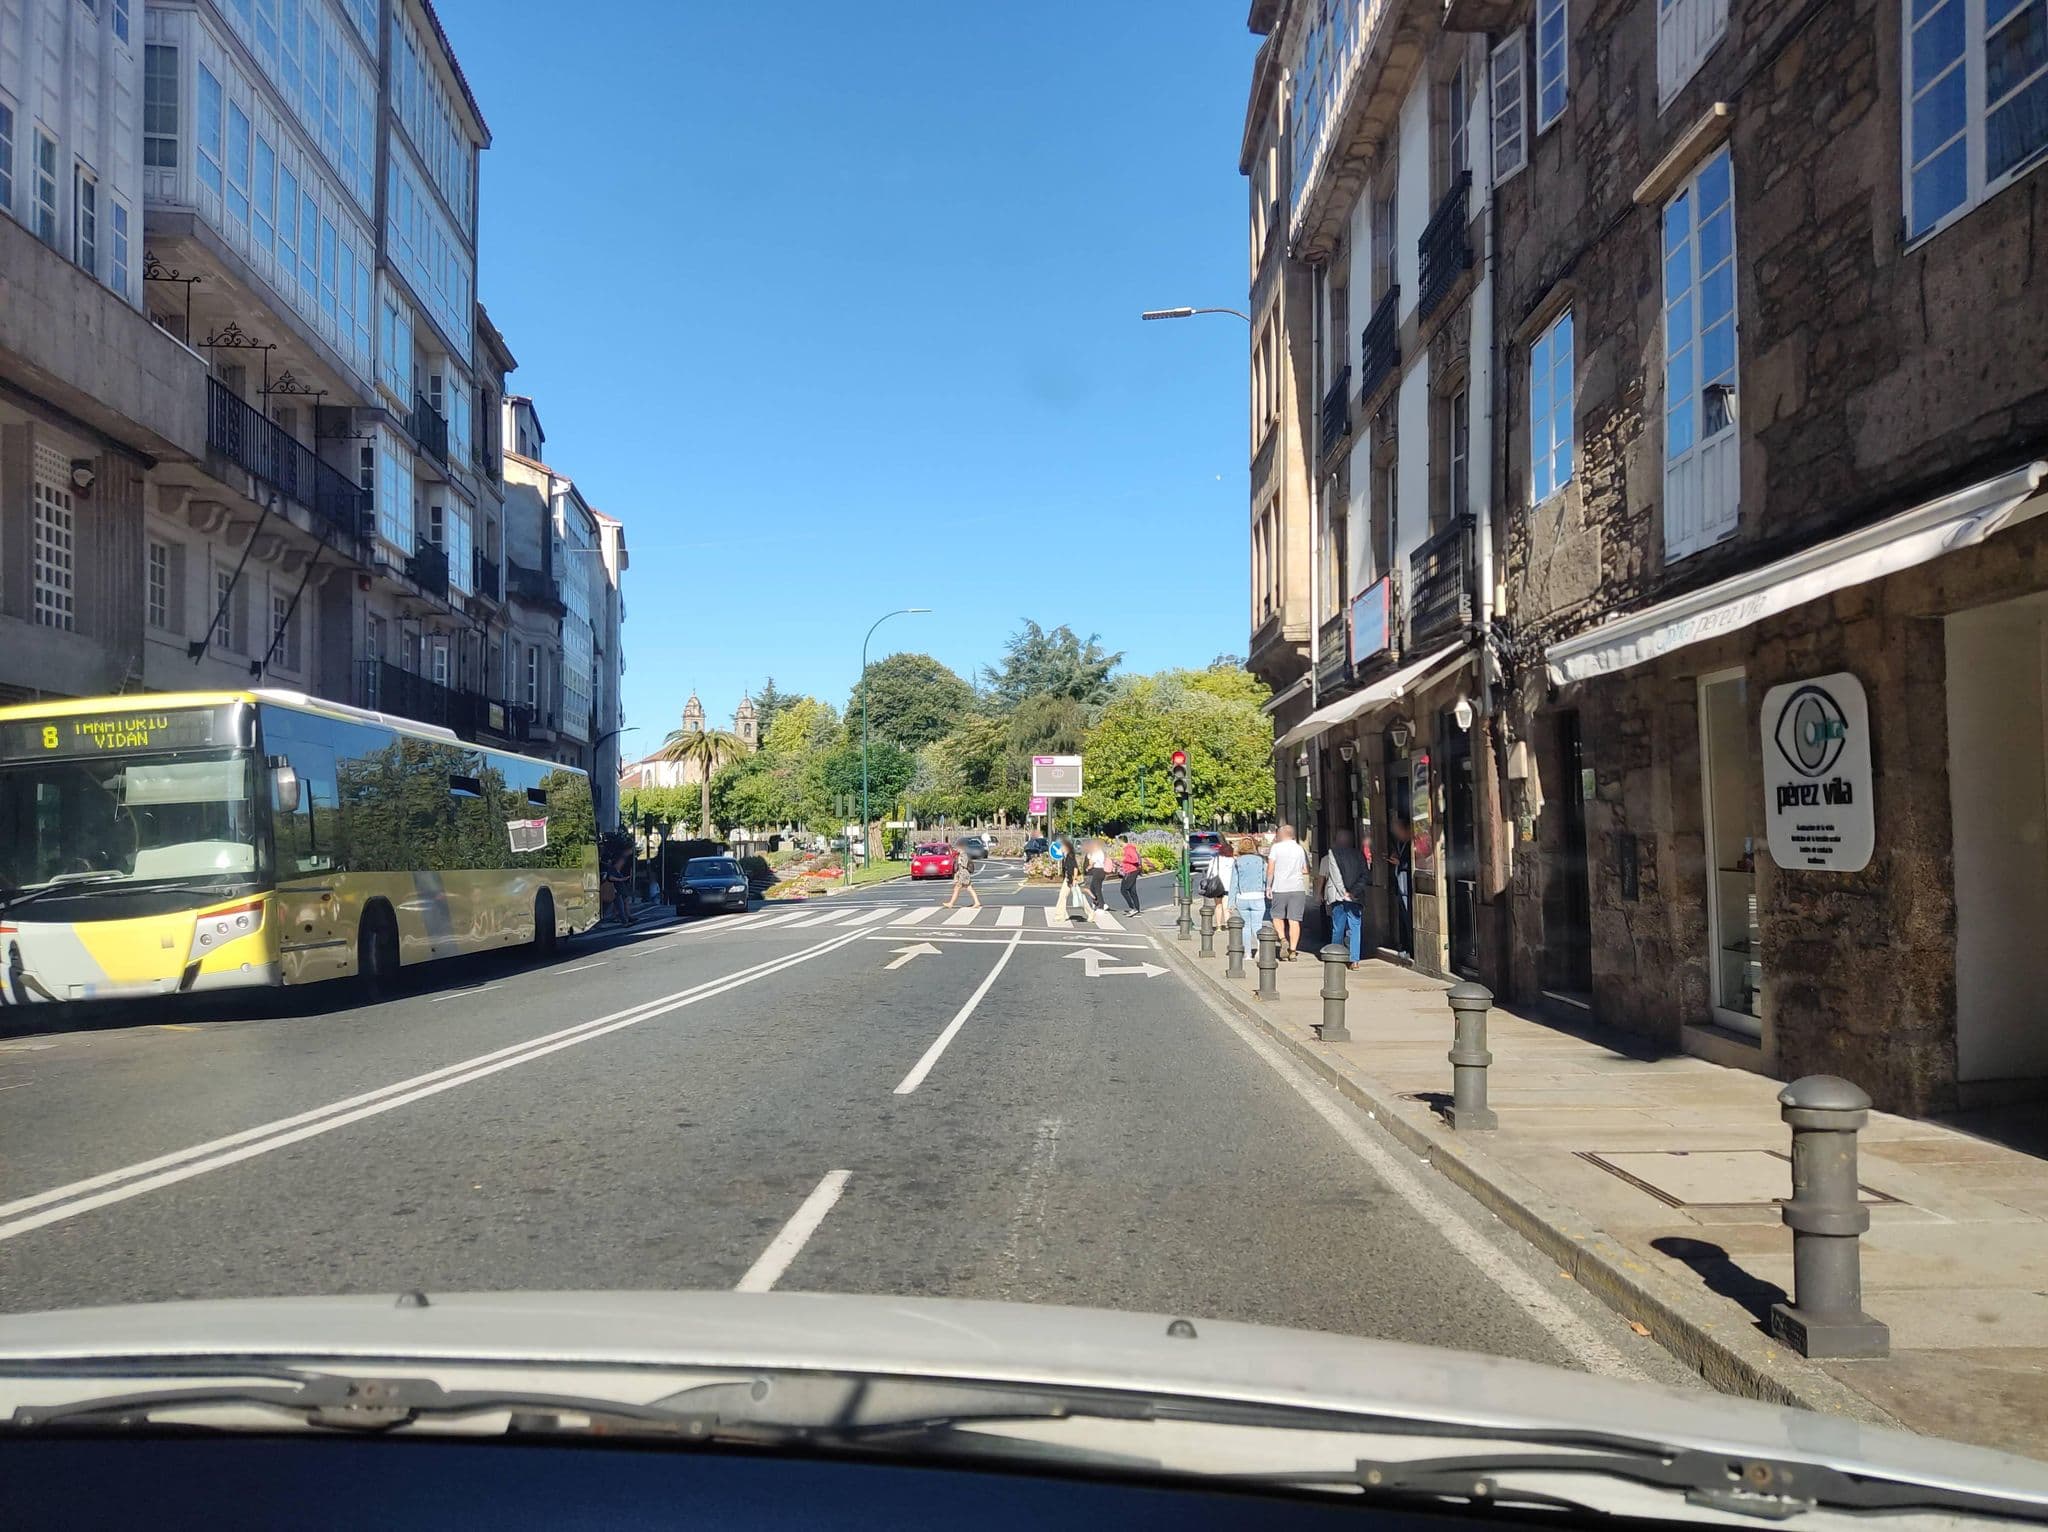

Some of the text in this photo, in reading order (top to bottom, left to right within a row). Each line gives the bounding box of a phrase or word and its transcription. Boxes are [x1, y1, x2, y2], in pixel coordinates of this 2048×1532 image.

[42, 726, 59, 749] 8
[95, 731, 149, 749] VIDAN
[1822, 776, 1853, 806] vila
